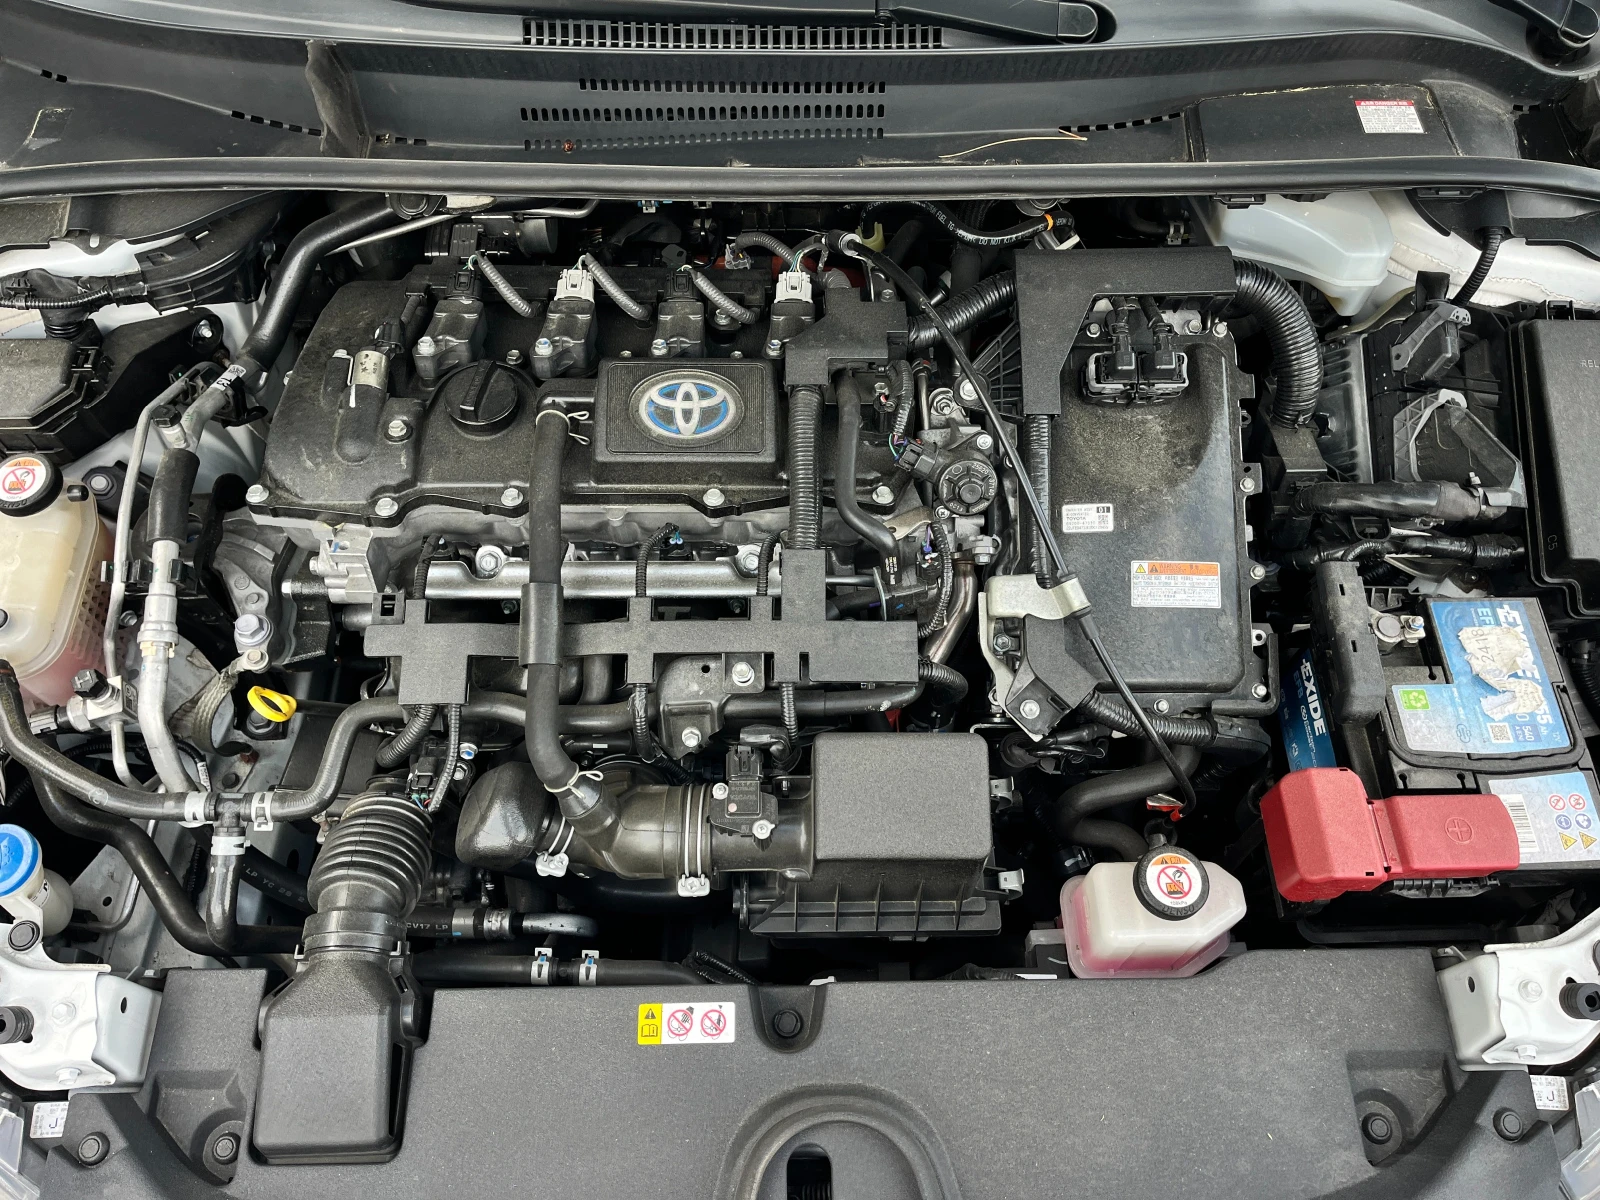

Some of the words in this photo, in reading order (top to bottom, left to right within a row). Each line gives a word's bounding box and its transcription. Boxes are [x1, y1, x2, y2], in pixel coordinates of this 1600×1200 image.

[1471, 627, 1496, 666] 2418
[1293, 670, 1304, 699] EFB
[1300, 658, 1327, 737] EXIDE
[1522, 725, 1535, 741] 540
[245, 867, 258, 877] LP
[1161, 904, 1195, 916] DENSO
